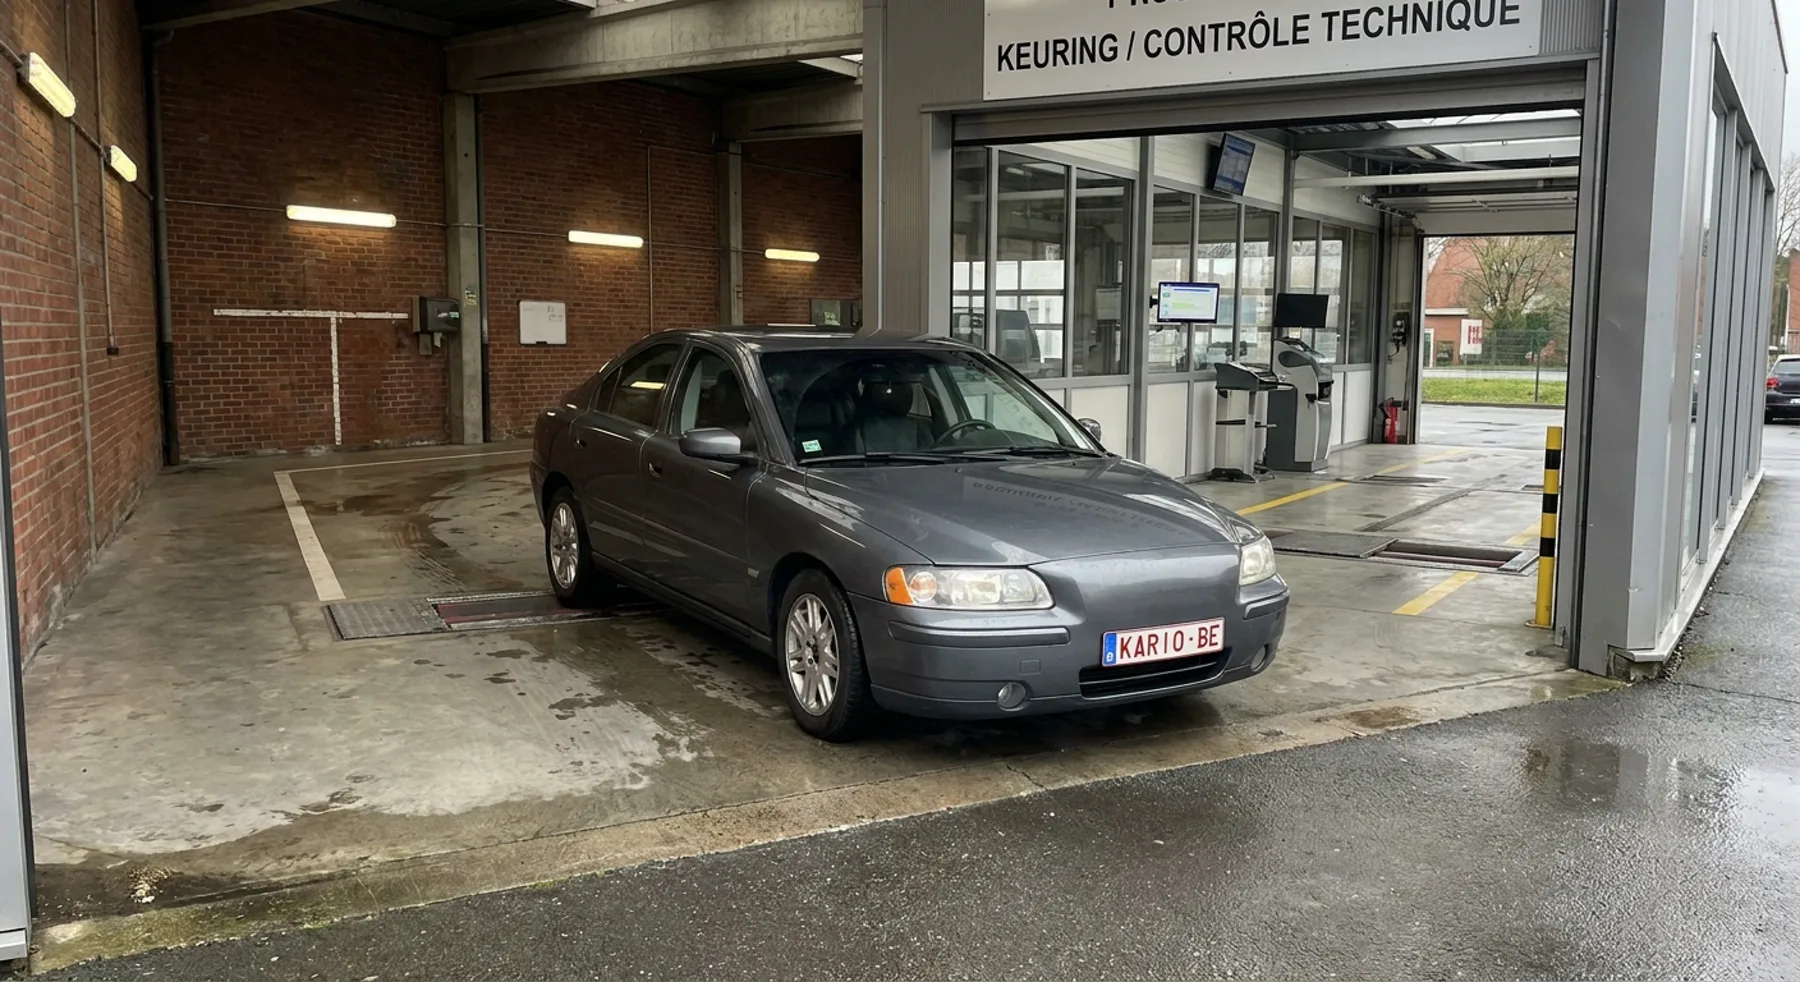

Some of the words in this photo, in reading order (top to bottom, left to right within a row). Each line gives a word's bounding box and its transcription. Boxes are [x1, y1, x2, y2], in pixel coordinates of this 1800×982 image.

[997, 33, 1118, 72] KEURING
[1126, 30, 1136, 61] /
[1143, 10, 1310, 59] CONTRÔLE
[1321, 0, 1520, 42] TECHNIQUE
